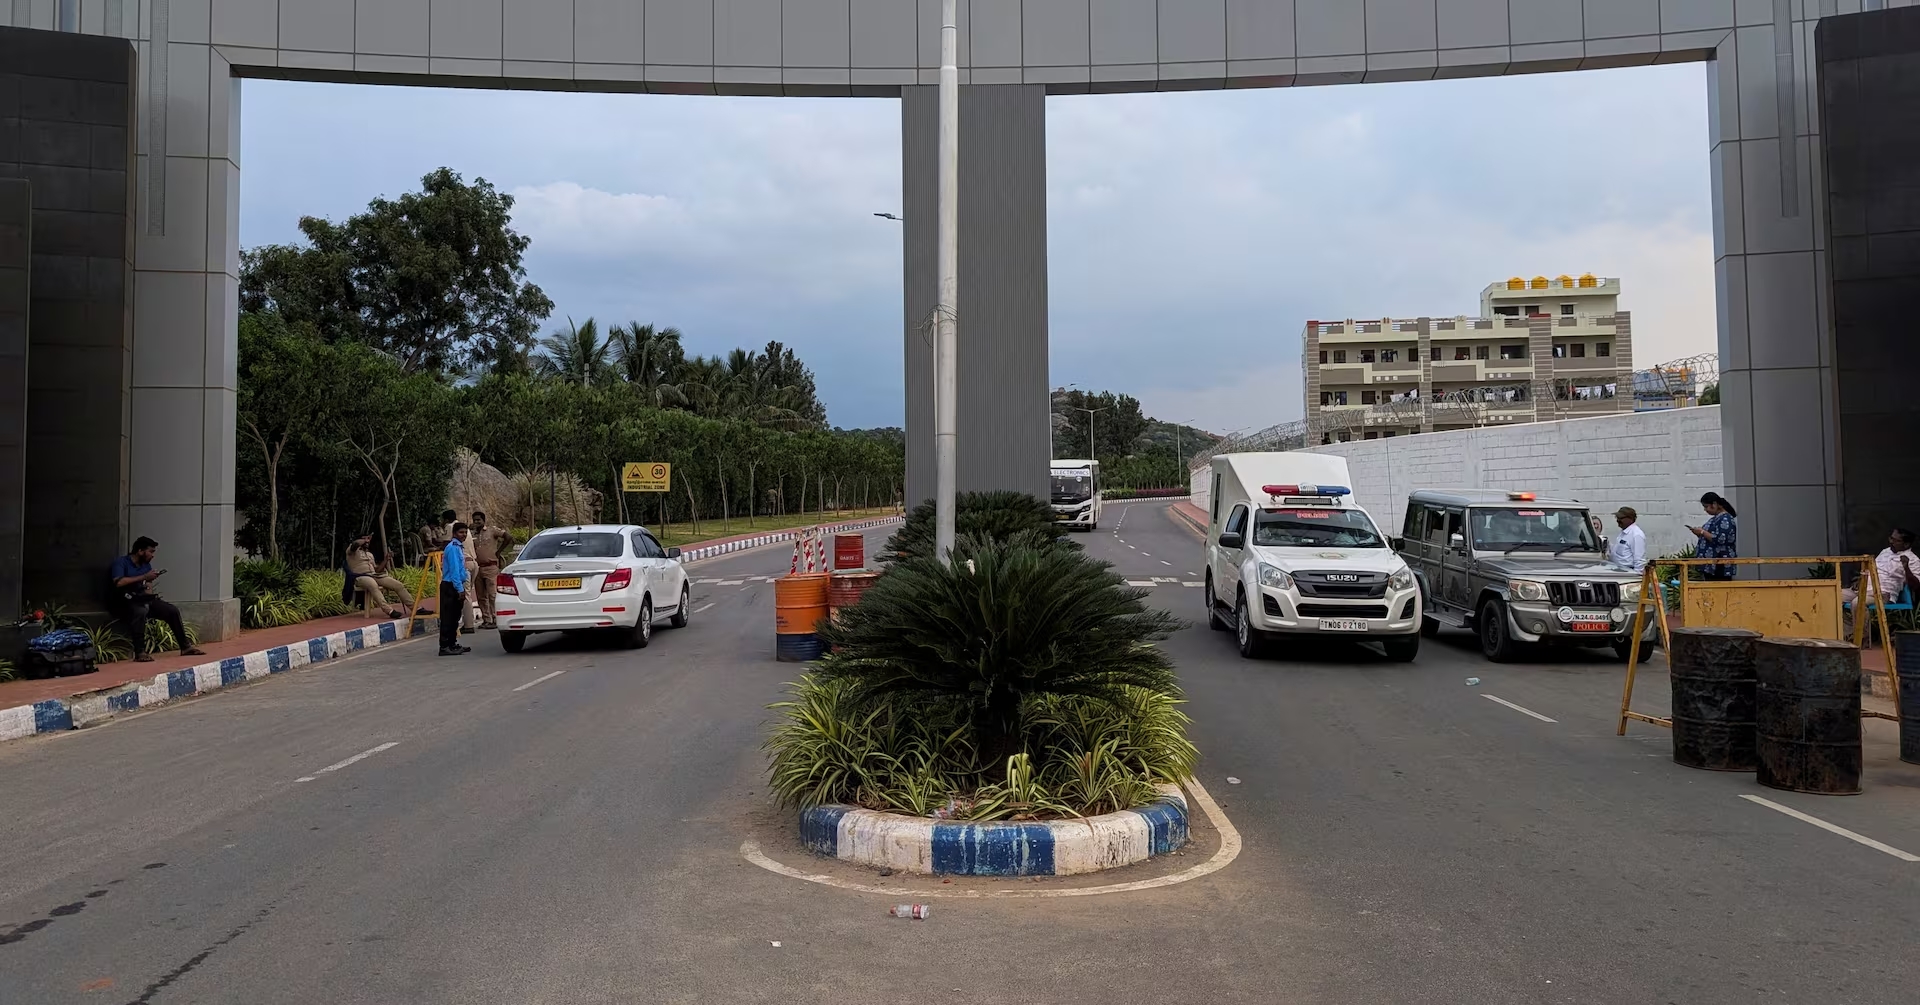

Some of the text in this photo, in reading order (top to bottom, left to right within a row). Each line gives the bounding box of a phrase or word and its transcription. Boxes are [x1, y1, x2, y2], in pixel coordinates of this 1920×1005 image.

[1326, 574, 1357, 582] ISUZU
[1348, 621, 1367, 630] 2180
[1576, 622, 1608, 630] POLICE
